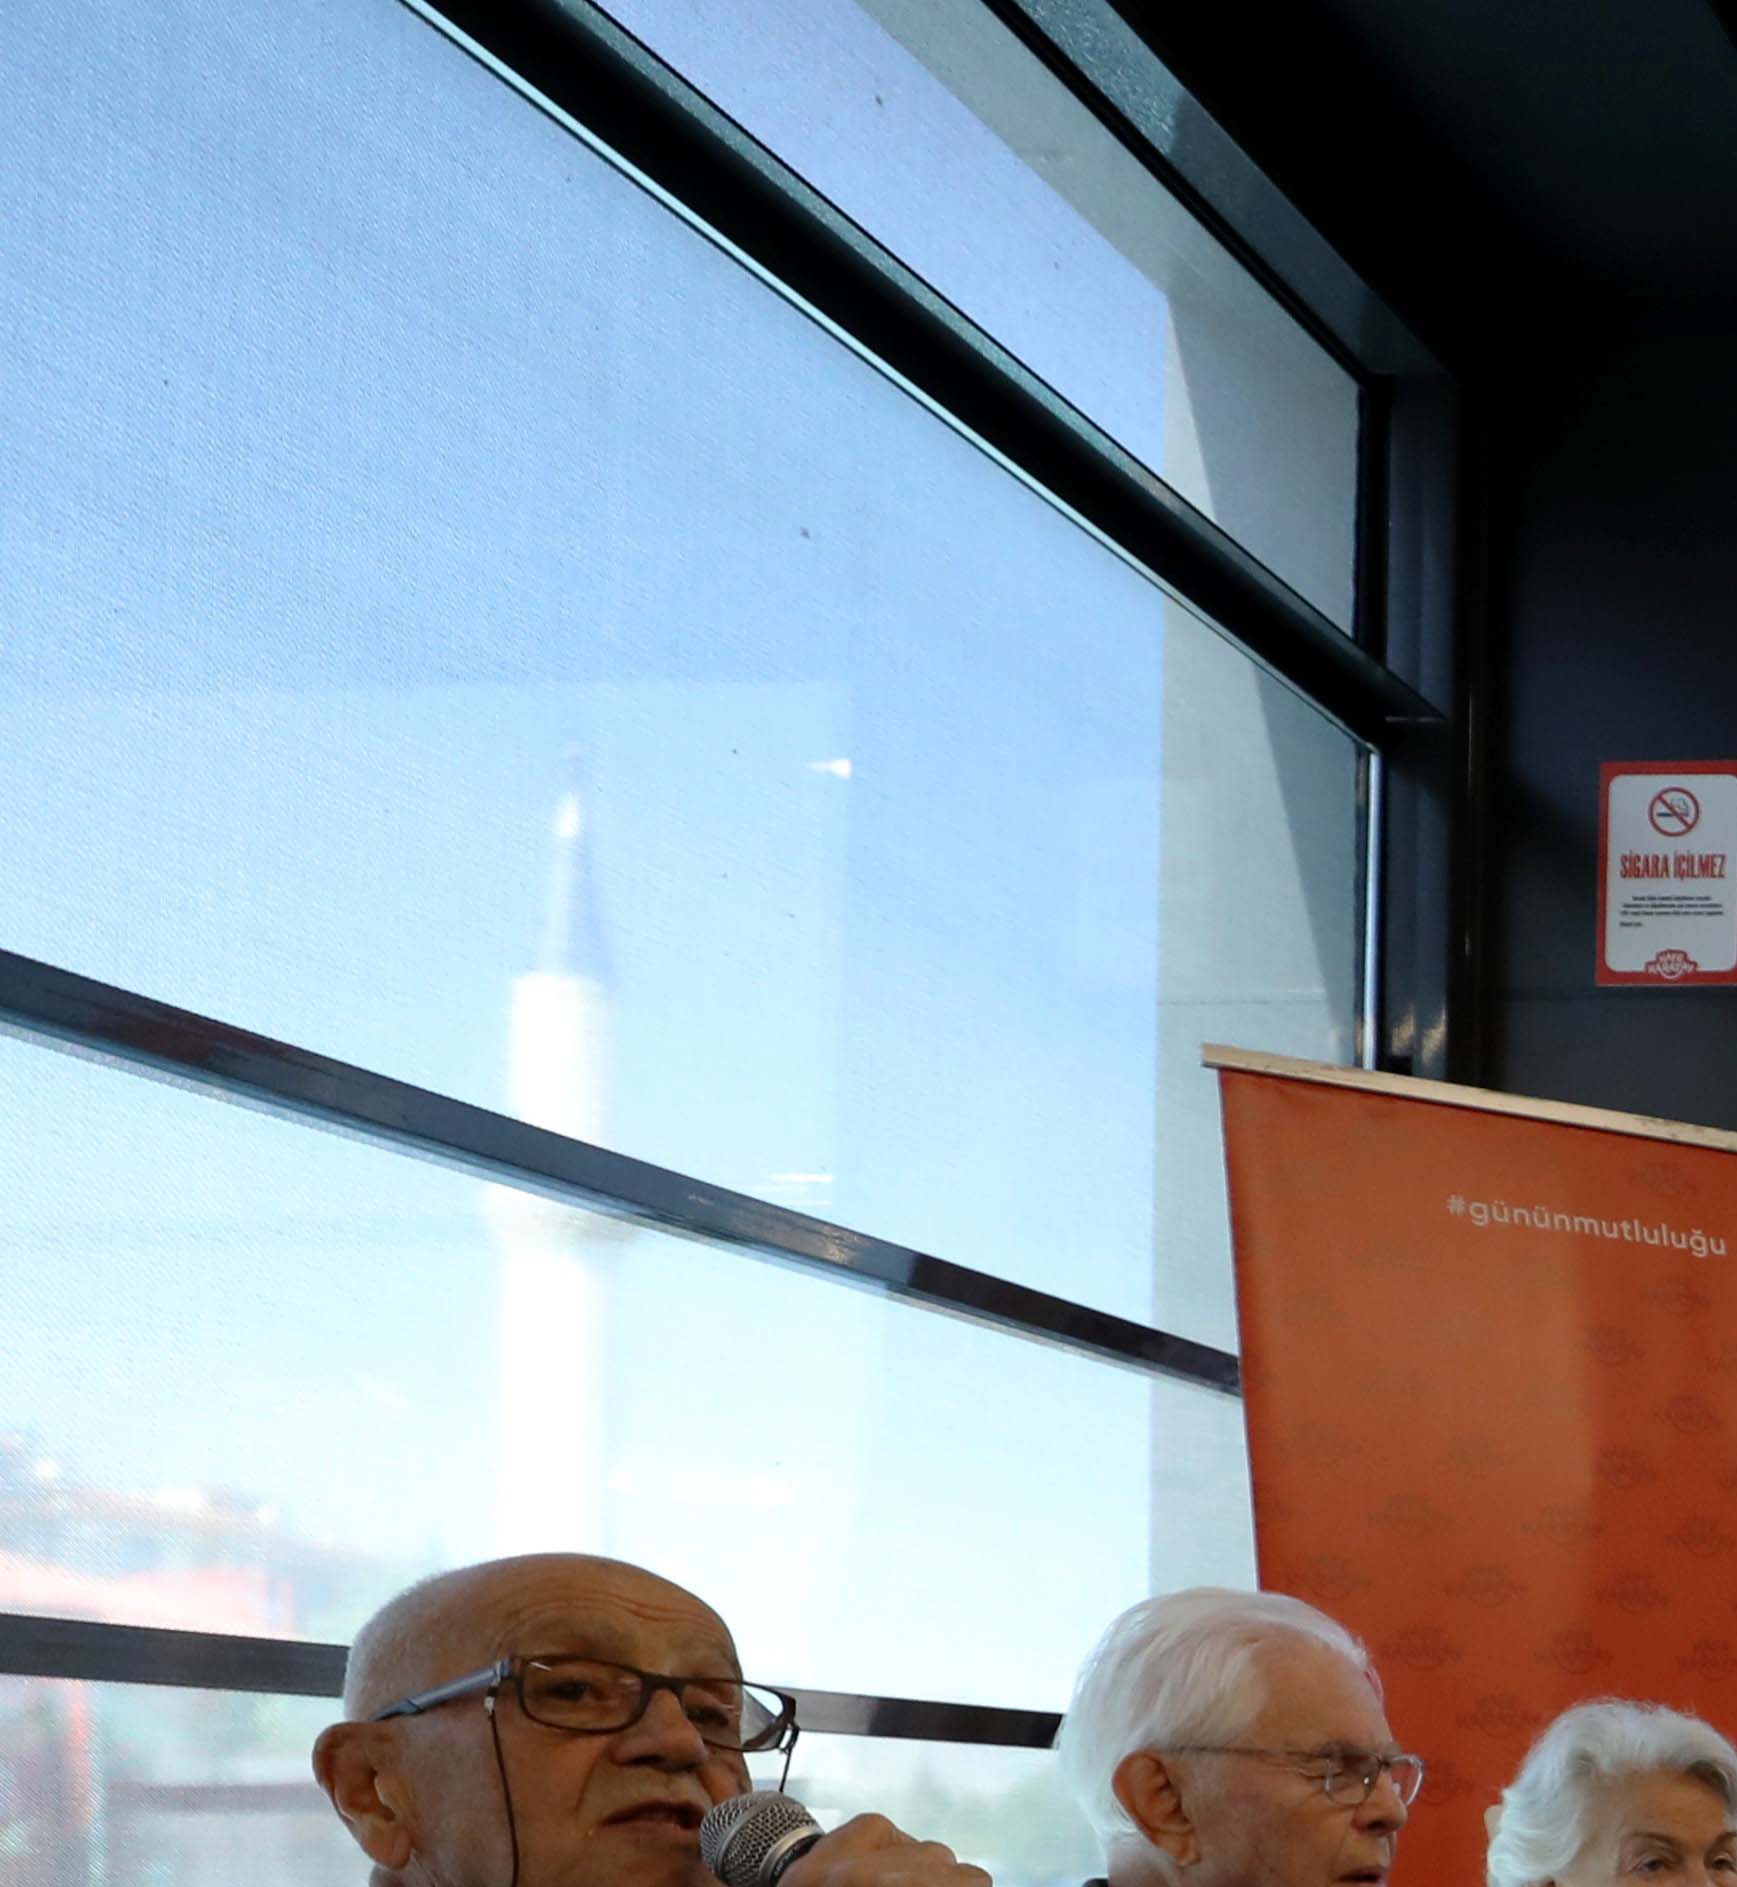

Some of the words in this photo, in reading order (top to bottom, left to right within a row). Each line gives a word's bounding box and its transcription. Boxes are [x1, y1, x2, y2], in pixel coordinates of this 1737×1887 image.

[1619, 849, 1670, 880] SİGARA
[1673, 849, 1726, 882] İÇİLMEZ
[1446, 1194, 1728, 1258] #gününmutluluğu
